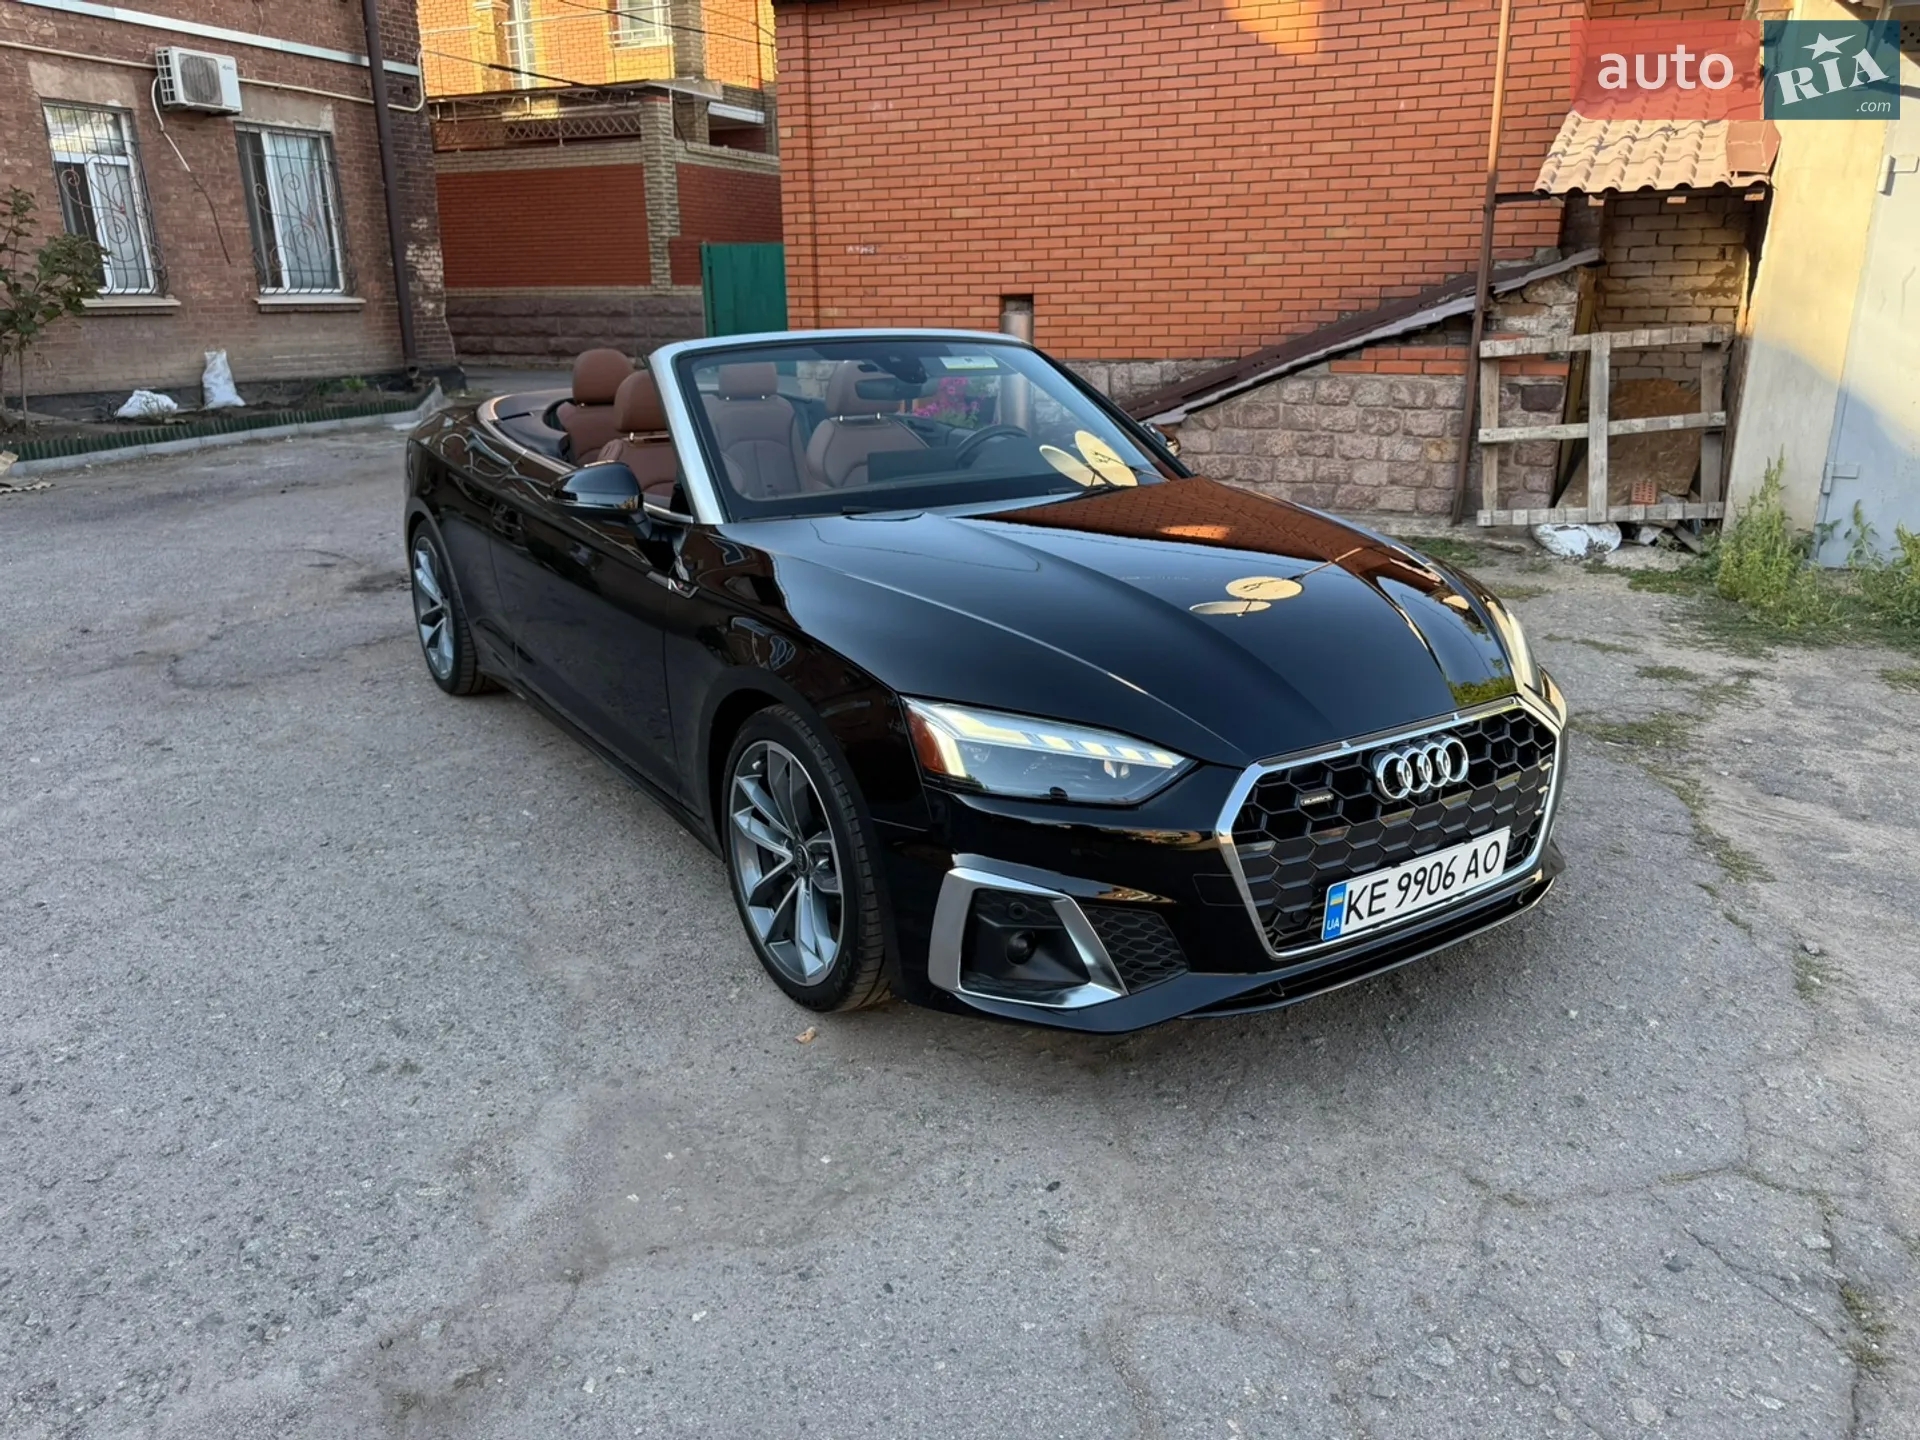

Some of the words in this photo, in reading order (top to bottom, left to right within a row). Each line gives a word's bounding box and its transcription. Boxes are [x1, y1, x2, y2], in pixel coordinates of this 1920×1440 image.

[1344, 878, 1389, 925] KE
[1395, 855, 1459, 909] 9906
[1463, 840, 1501, 884] AO
[1326, 917, 1340, 931] UA
